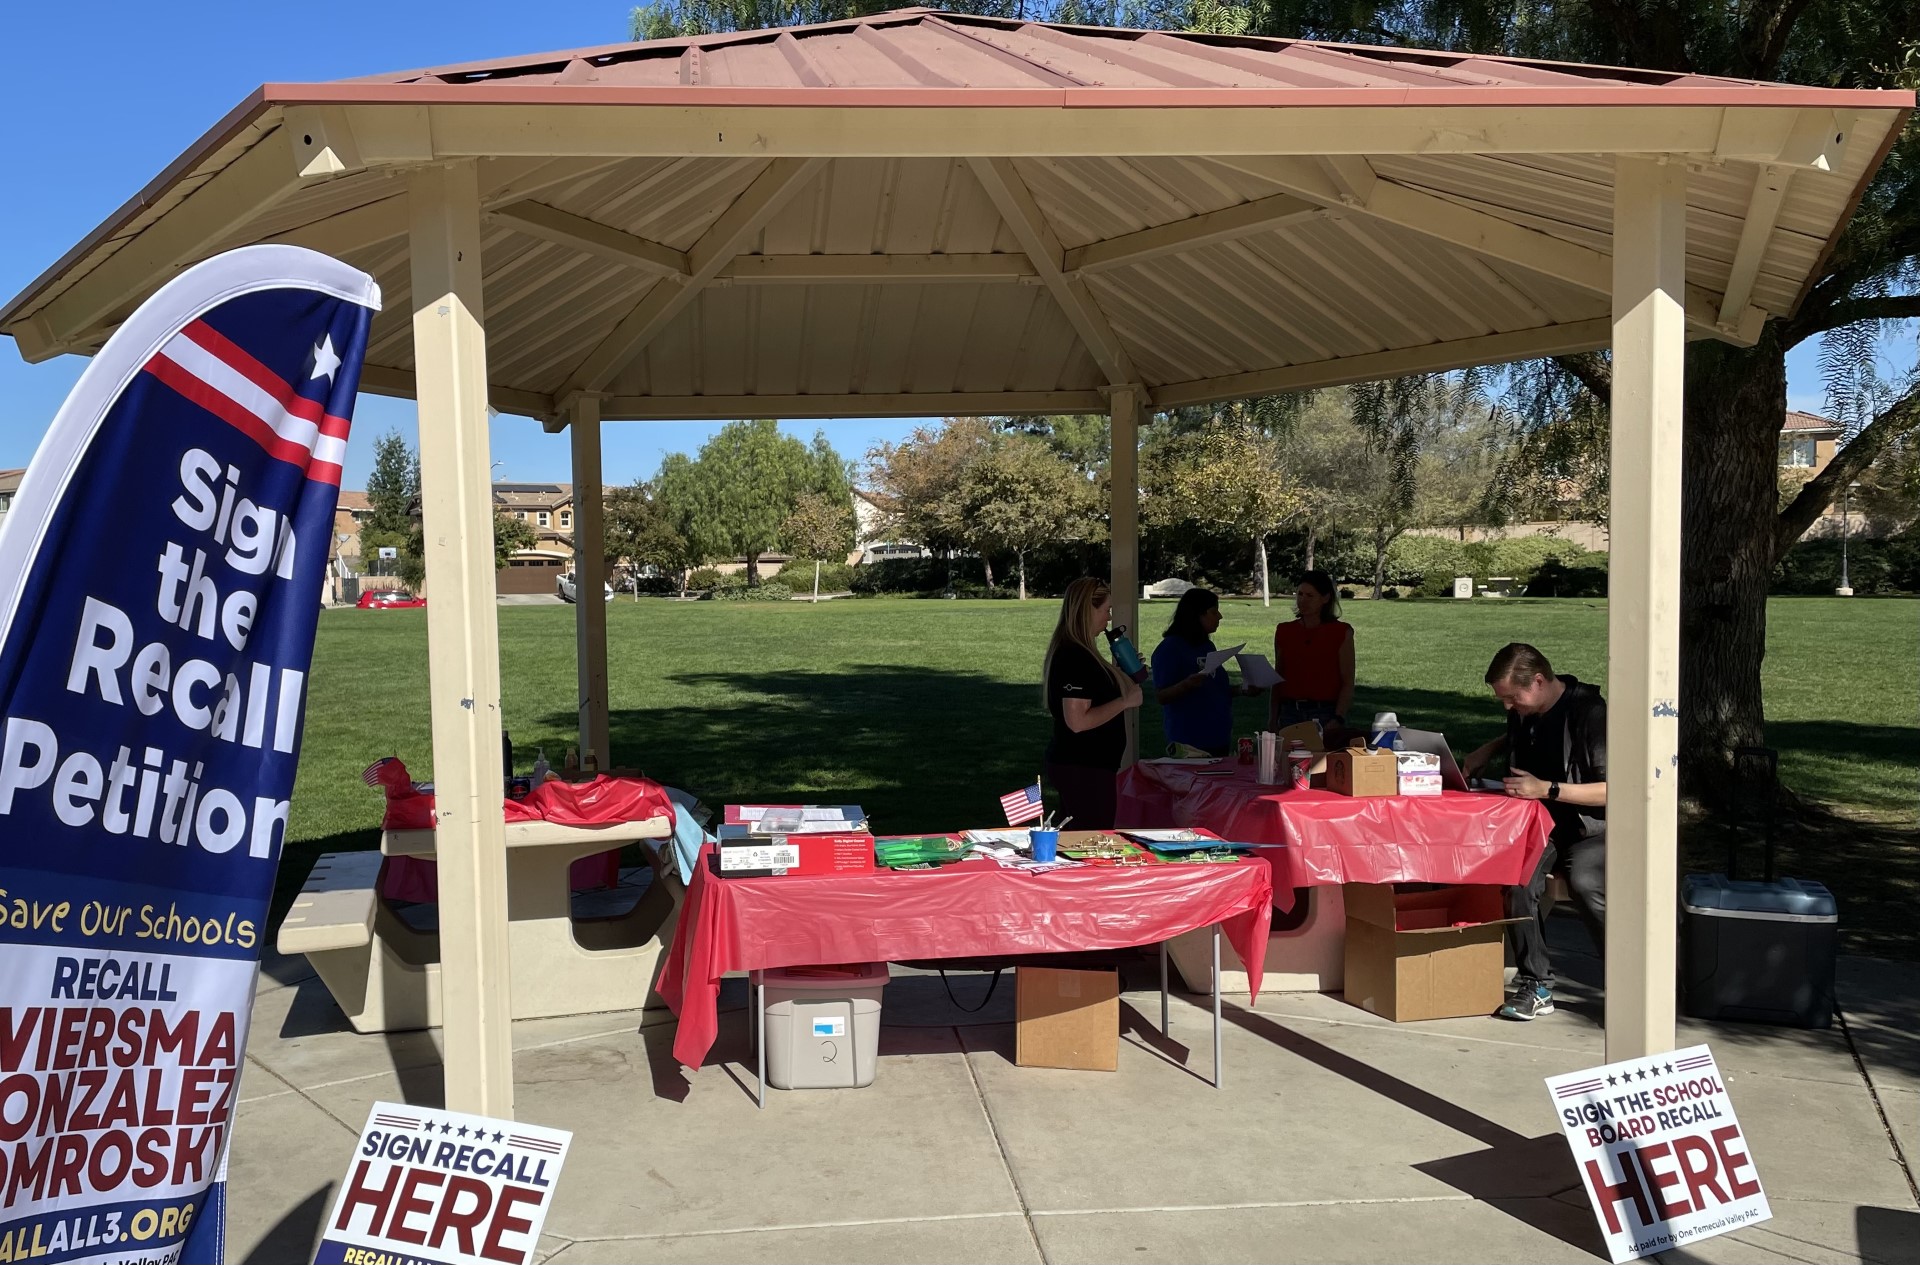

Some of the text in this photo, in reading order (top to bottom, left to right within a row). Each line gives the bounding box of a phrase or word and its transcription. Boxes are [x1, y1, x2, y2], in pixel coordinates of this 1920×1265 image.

[172, 448, 296, 580] Sign
[157, 541, 258, 652] the
[66, 595, 304, 754] Recall
[0, 716, 290, 860] Petition
[135, 901, 257, 949] Schools
[51, 957, 177, 1001] RECALL
[1563, 1075, 1723, 1128] SIGN THE SCHOOL
[1586, 1099, 1722, 1148] BOARD RECALL
[0, 1124, 224, 1209] MROSK
[362, 1130, 550, 1187] SIGN RECALL
[1584, 1124, 1761, 1235] HERE
[334, 1159, 545, 1265] HERE
[1628, 1208, 1759, 1253] Ad paid for by One Temecula Valley PAC
